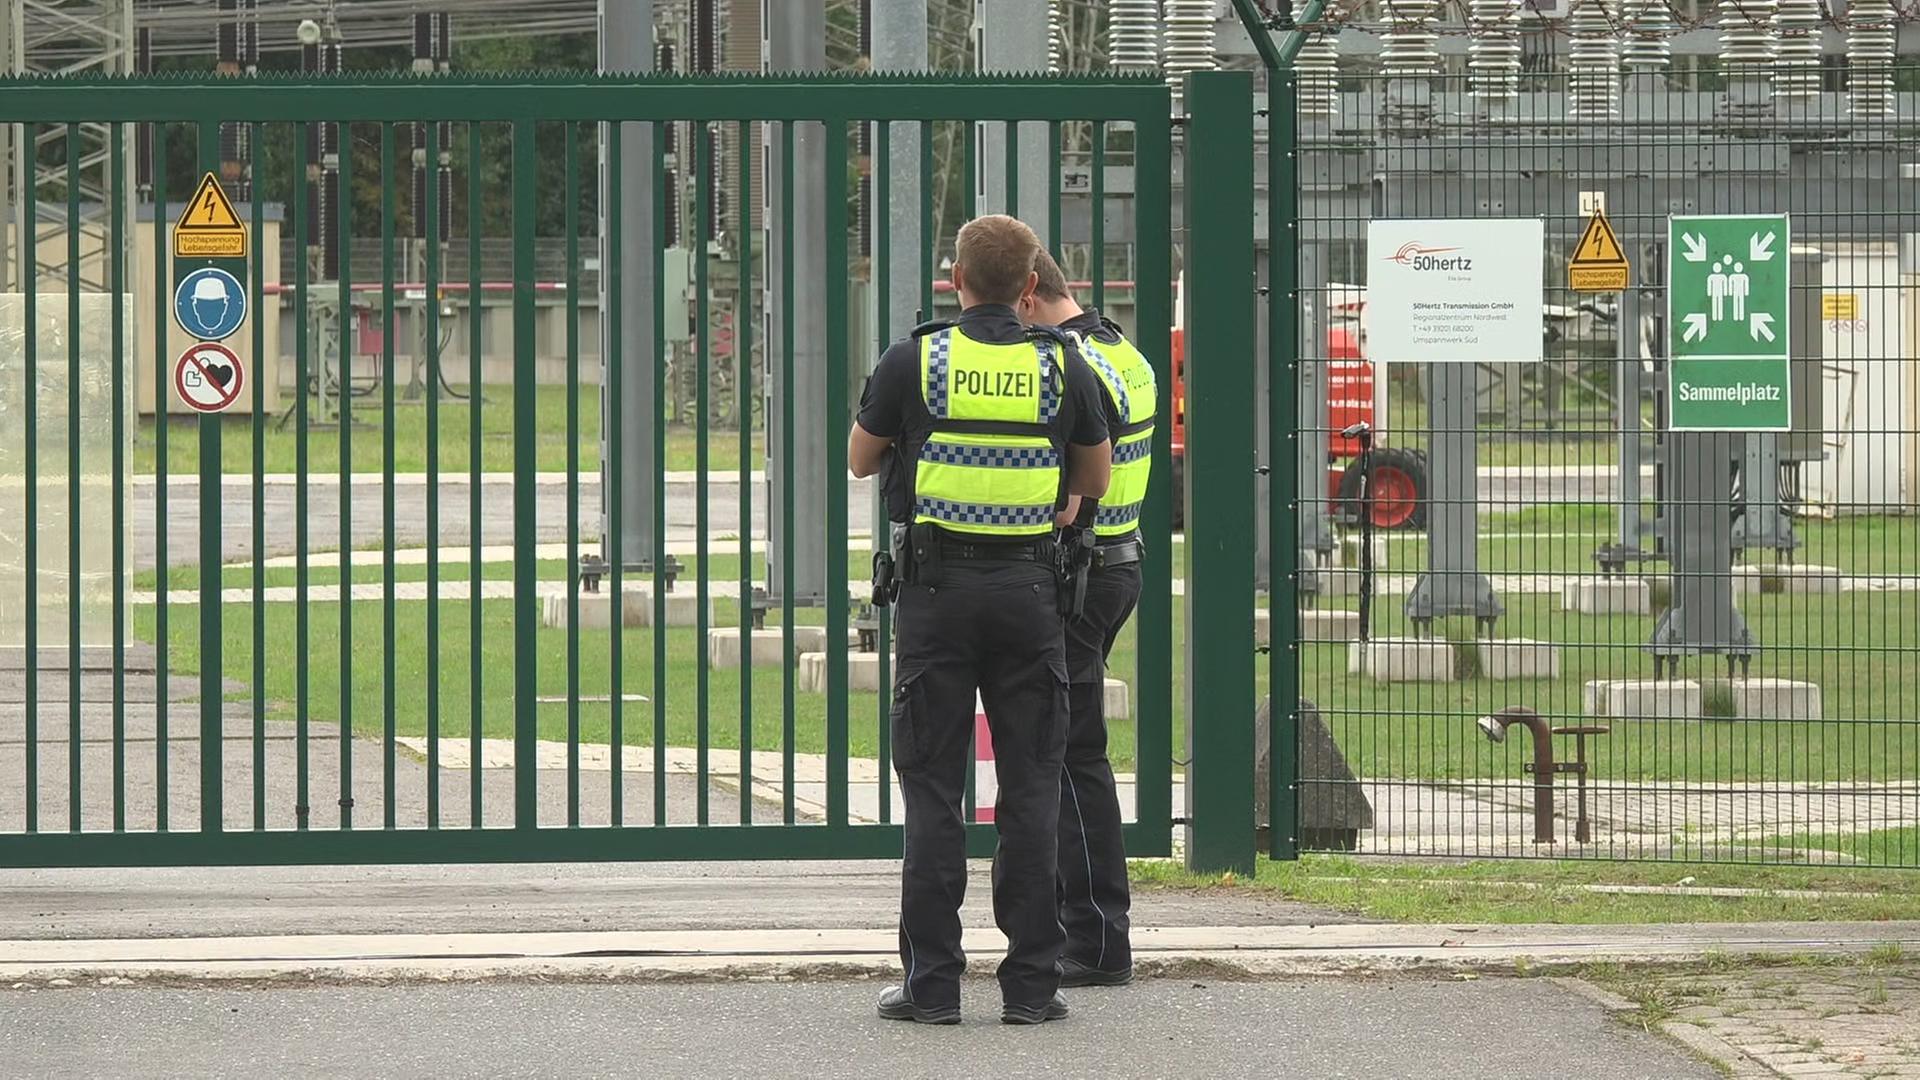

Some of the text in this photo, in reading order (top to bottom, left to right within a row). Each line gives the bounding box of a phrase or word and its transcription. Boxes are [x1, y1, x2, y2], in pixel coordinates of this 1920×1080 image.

[180, 235, 240, 244] Hochspannung
[184, 244, 238, 252] Lebensgefahr
[1413, 255, 1472, 271] 50hertz
[1573, 271, 1624, 279] Hochspannung
[1575, 279, 1621, 287] Lebensgefahr
[1413, 302, 1514, 310] 50Hertz Transmission GmbH
[1413, 313, 1506, 322] Regionalzentrum Nordwest
[1464, 335, 1479, 344] Süd
[954, 369, 1034, 398] POLIZEI
[1679, 382, 1781, 406] Sammelplatz
